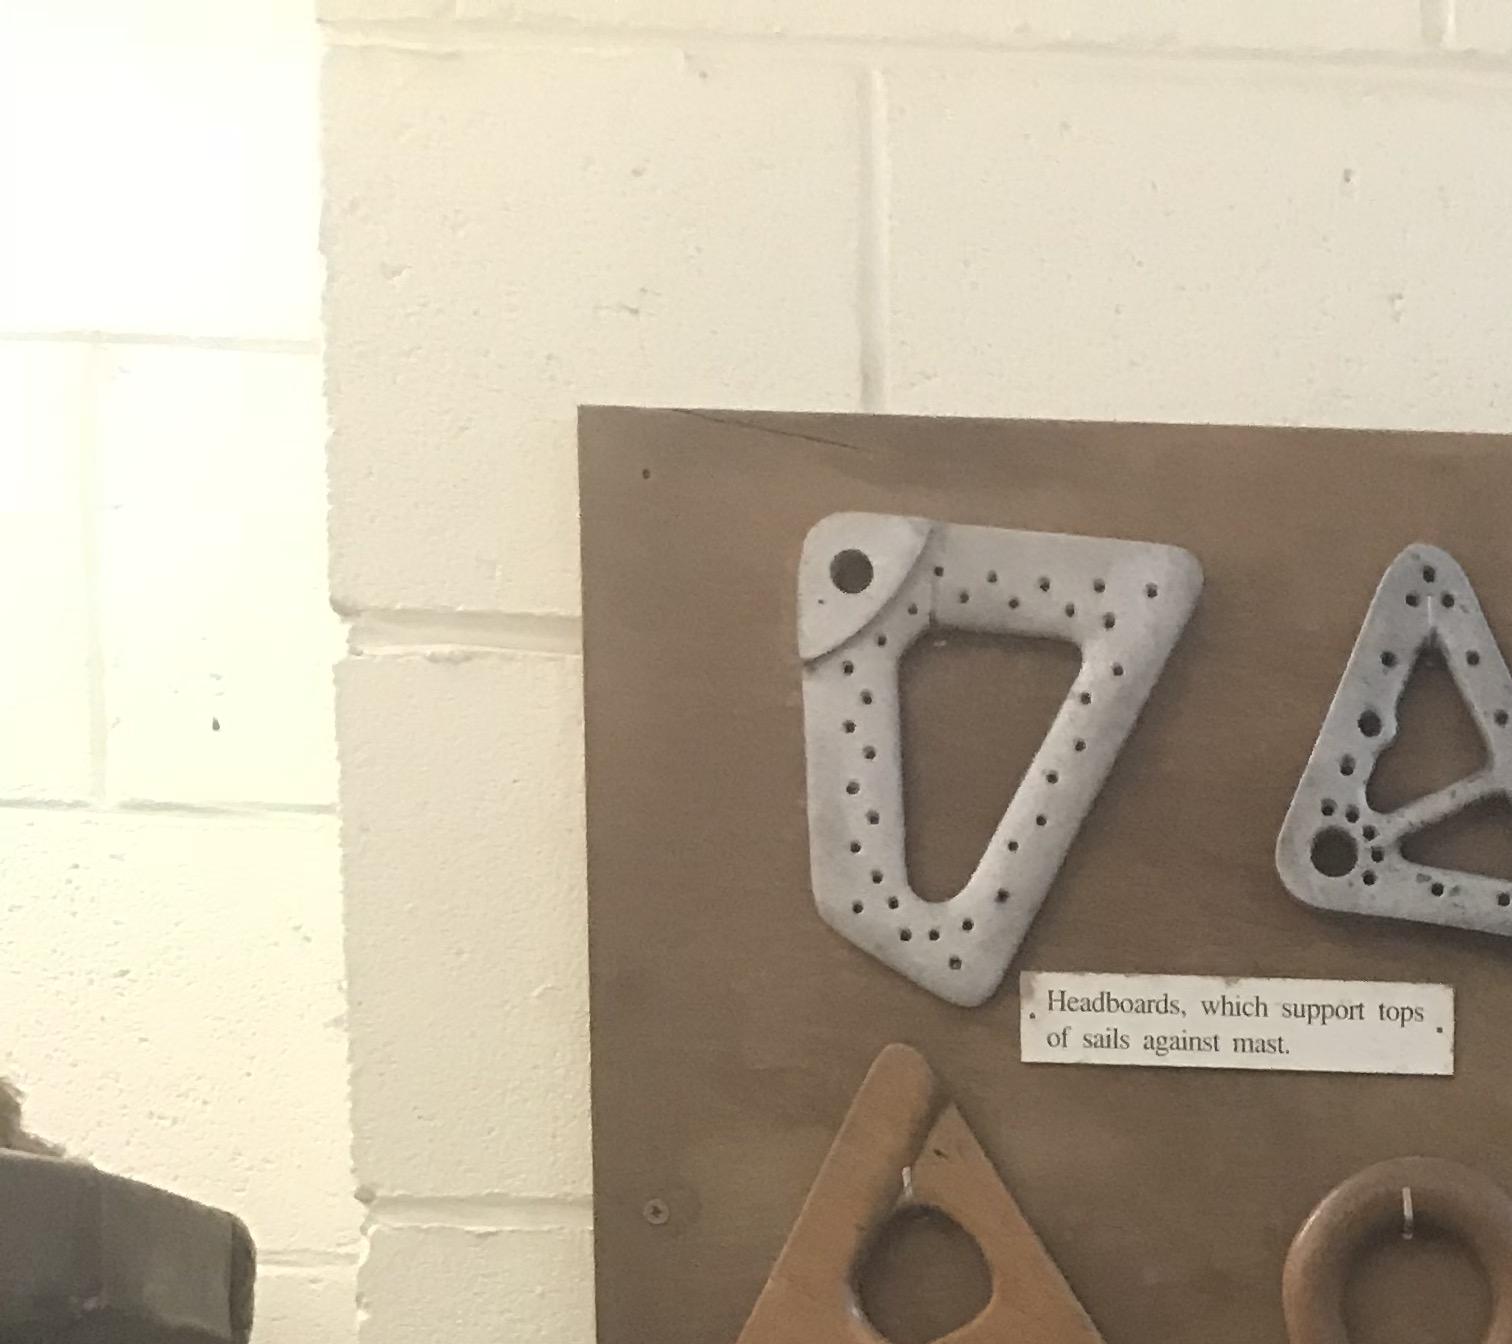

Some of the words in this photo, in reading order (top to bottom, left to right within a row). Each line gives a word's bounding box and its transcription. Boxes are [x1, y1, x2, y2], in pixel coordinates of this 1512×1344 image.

[1047, 989, 1187, 1018] Headboards,
[1200, 994, 1269, 1018] which
[1281, 1002, 1365, 1026] support
[1378, 1002, 1425, 1029] tops
[1046, 1025, 1072, 1049] of
[1082, 1027, 1130, 1050] sails
[1143, 1034, 1220, 1057] against
[1232, 1035, 1290, 1055] mast.
